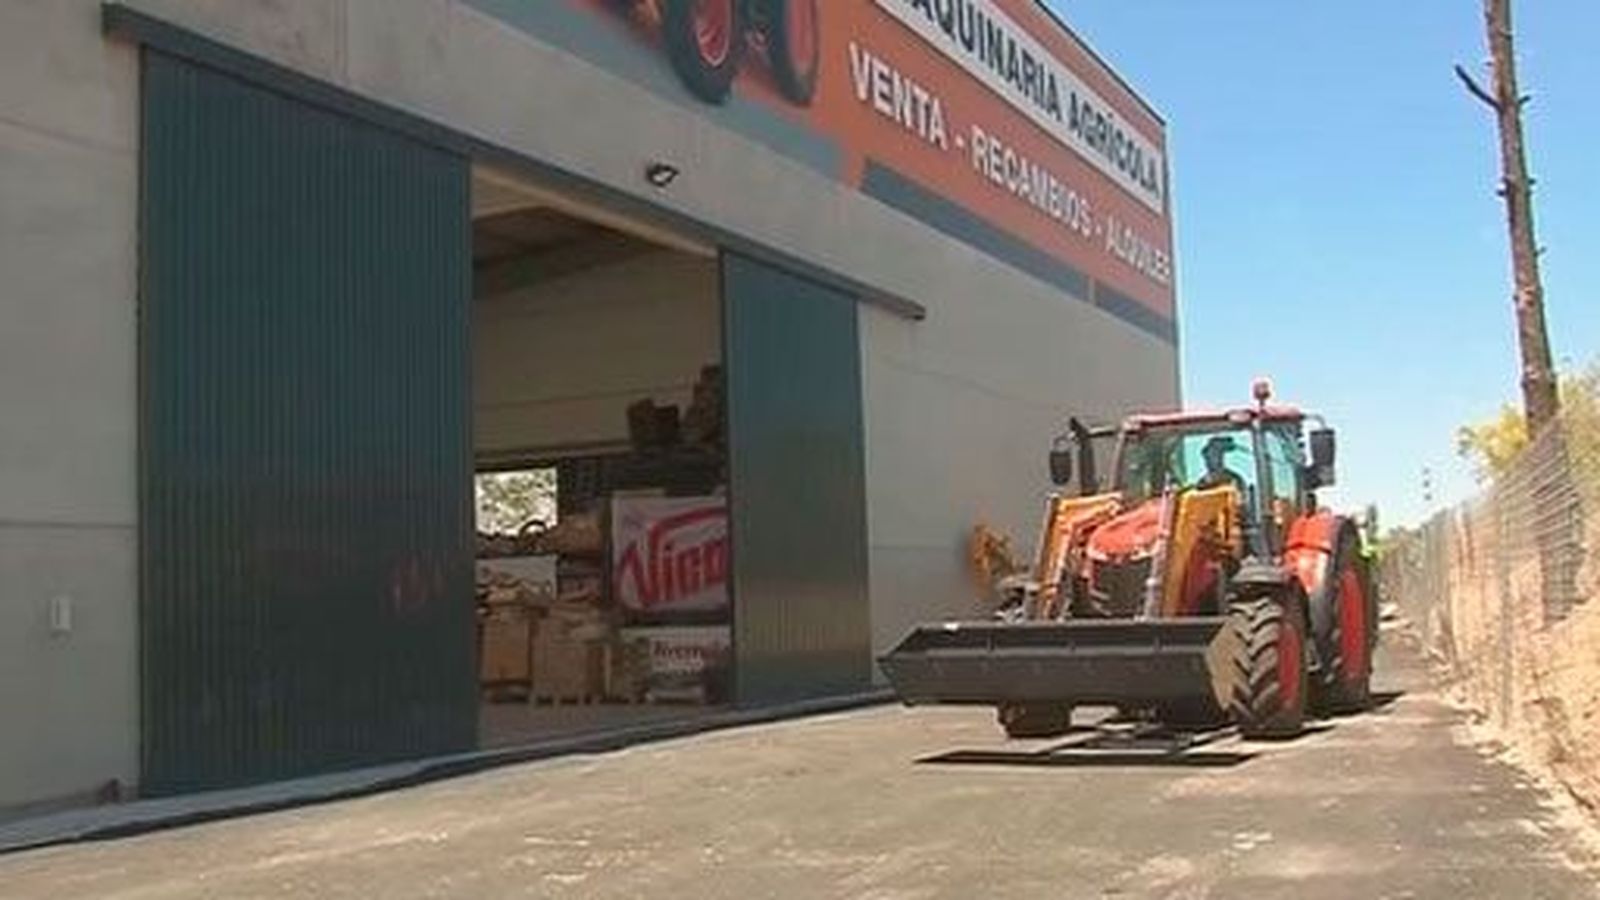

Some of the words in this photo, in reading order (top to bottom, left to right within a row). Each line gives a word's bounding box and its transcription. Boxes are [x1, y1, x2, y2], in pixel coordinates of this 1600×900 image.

[849, 42, 949, 150] VENTA
[971, 124, 1092, 236] RECAMBIOS
[1106, 216, 1171, 284] ALQUILER
